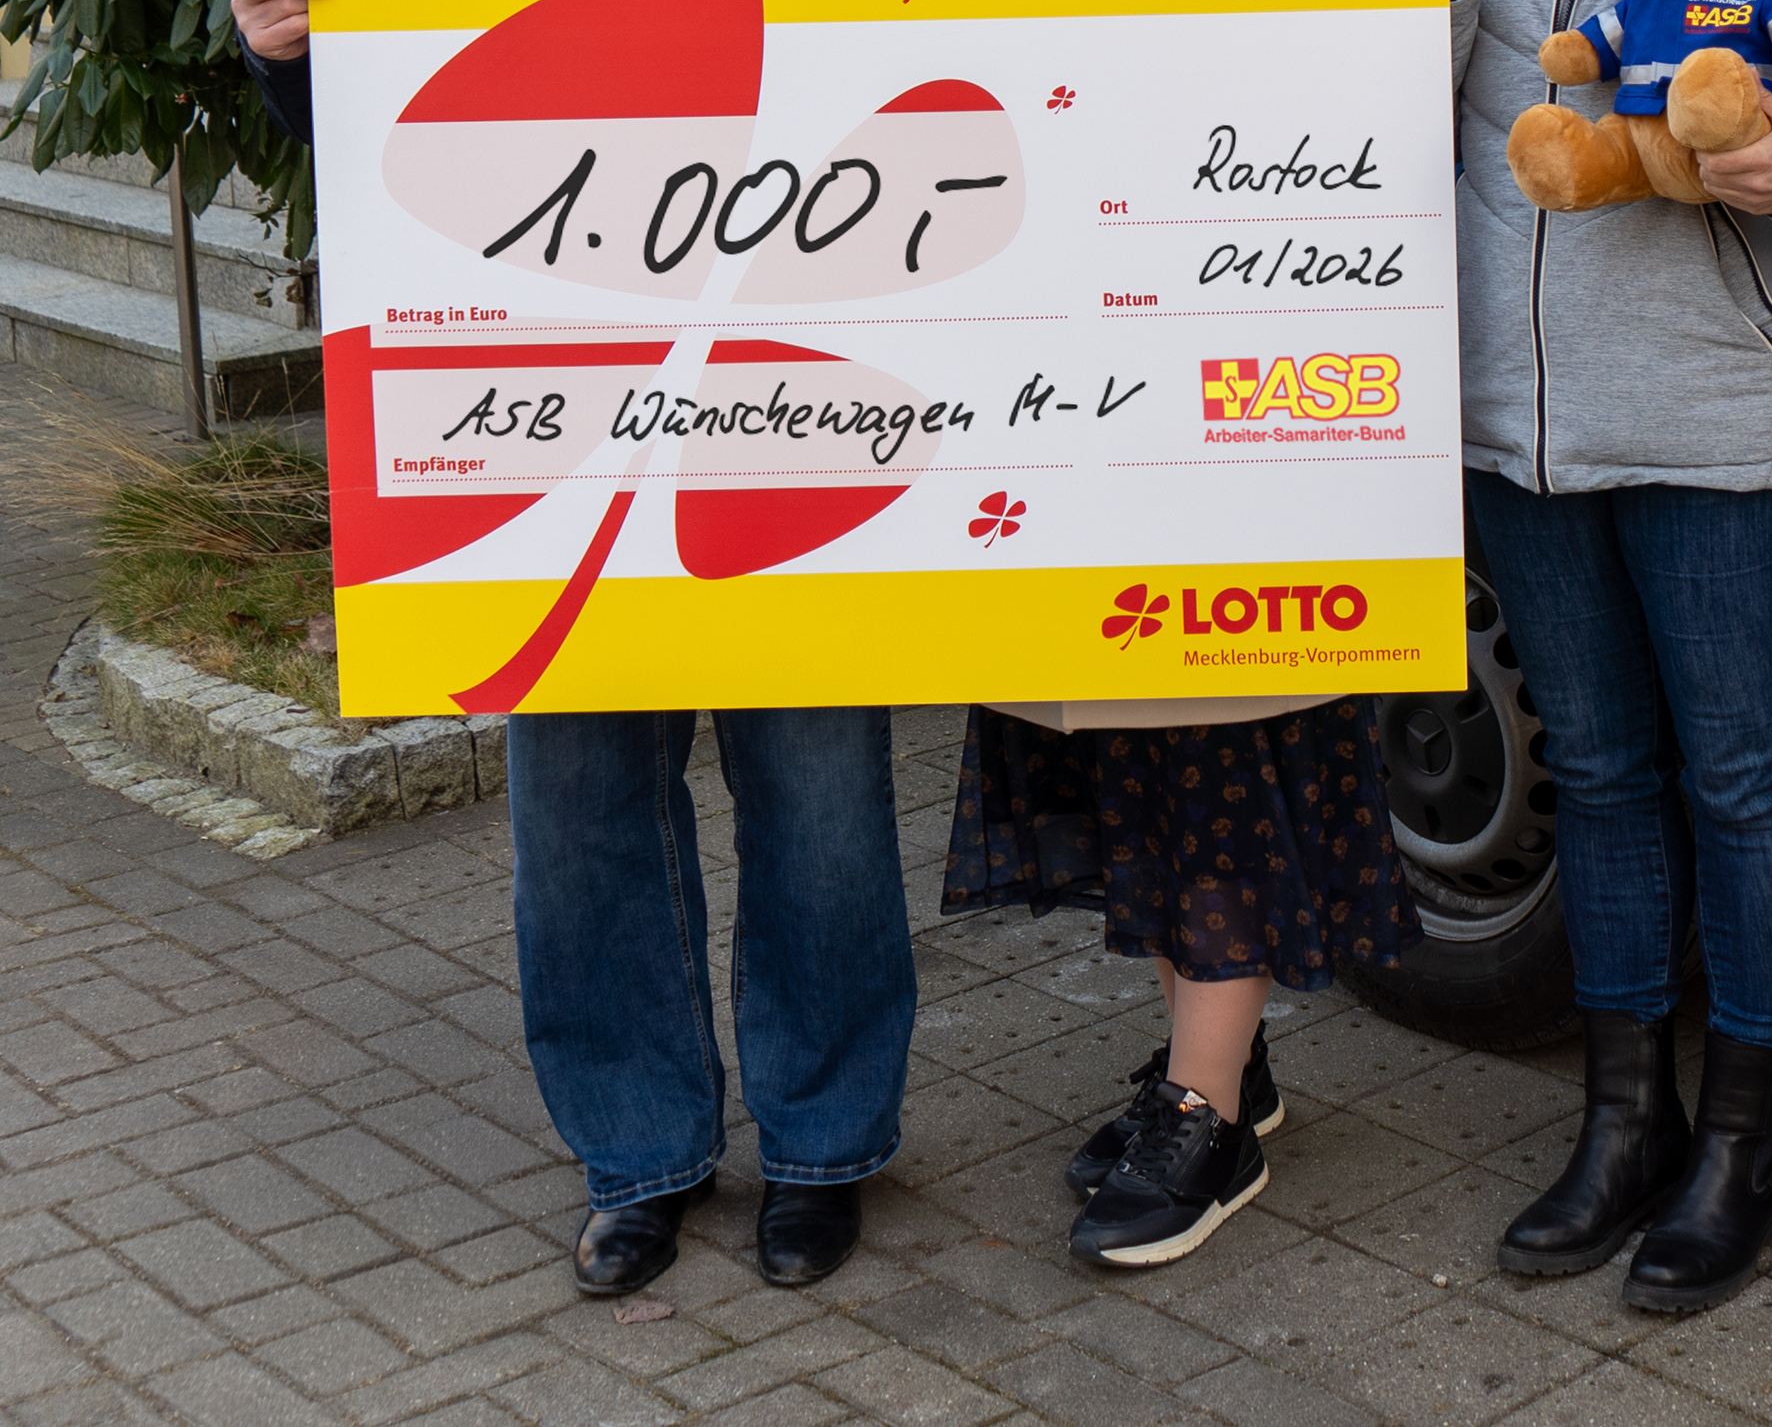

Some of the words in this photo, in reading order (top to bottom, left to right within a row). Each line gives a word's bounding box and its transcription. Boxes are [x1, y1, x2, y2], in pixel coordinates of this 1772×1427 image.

[1701, 4, 1753, 27] ASB
[1193, 125, 1382, 195] Rostock
[1099, 200, 1129, 215] Ort
[1199, 239, 1403, 288] 01/2026
[1103, 292, 1158, 307] Datum
[386, 307, 444, 326] Betrag
[448, 306, 465, 322] in
[469, 305, 508, 322] Euro
[1246, 353, 1402, 422] ASB
[442, 388, 566, 441] ASB
[610, 381, 976, 465] Wünschewagen
[1204, 425, 1406, 443] Arbeiter-Samariter-Bund
[393, 456, 486, 476] Empfänger
[1181, 584, 1369, 635] LOTTO
[1183, 646, 1421, 668] Mecklenburg-Vorpommern
